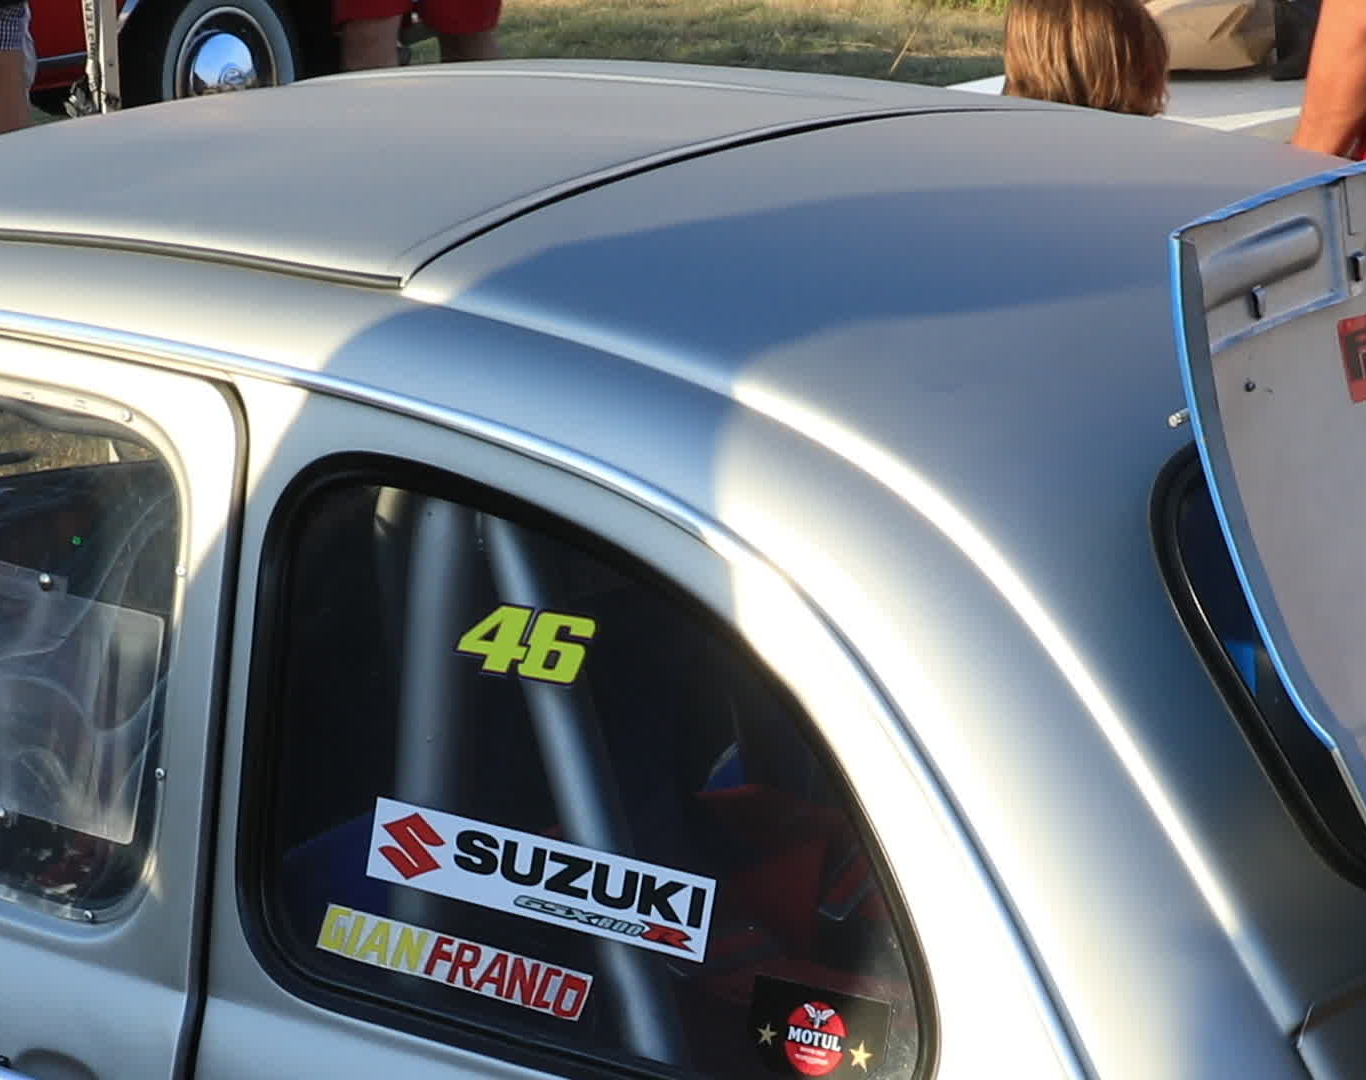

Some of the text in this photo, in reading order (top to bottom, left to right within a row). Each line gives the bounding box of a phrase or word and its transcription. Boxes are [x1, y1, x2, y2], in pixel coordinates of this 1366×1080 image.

[456, 604, 596, 684] 46
[453, 829, 707, 928] SUZUKI
[319, 907, 588, 1018] GIANFRANCO
[787, 1026, 842, 1053] MOTUL
